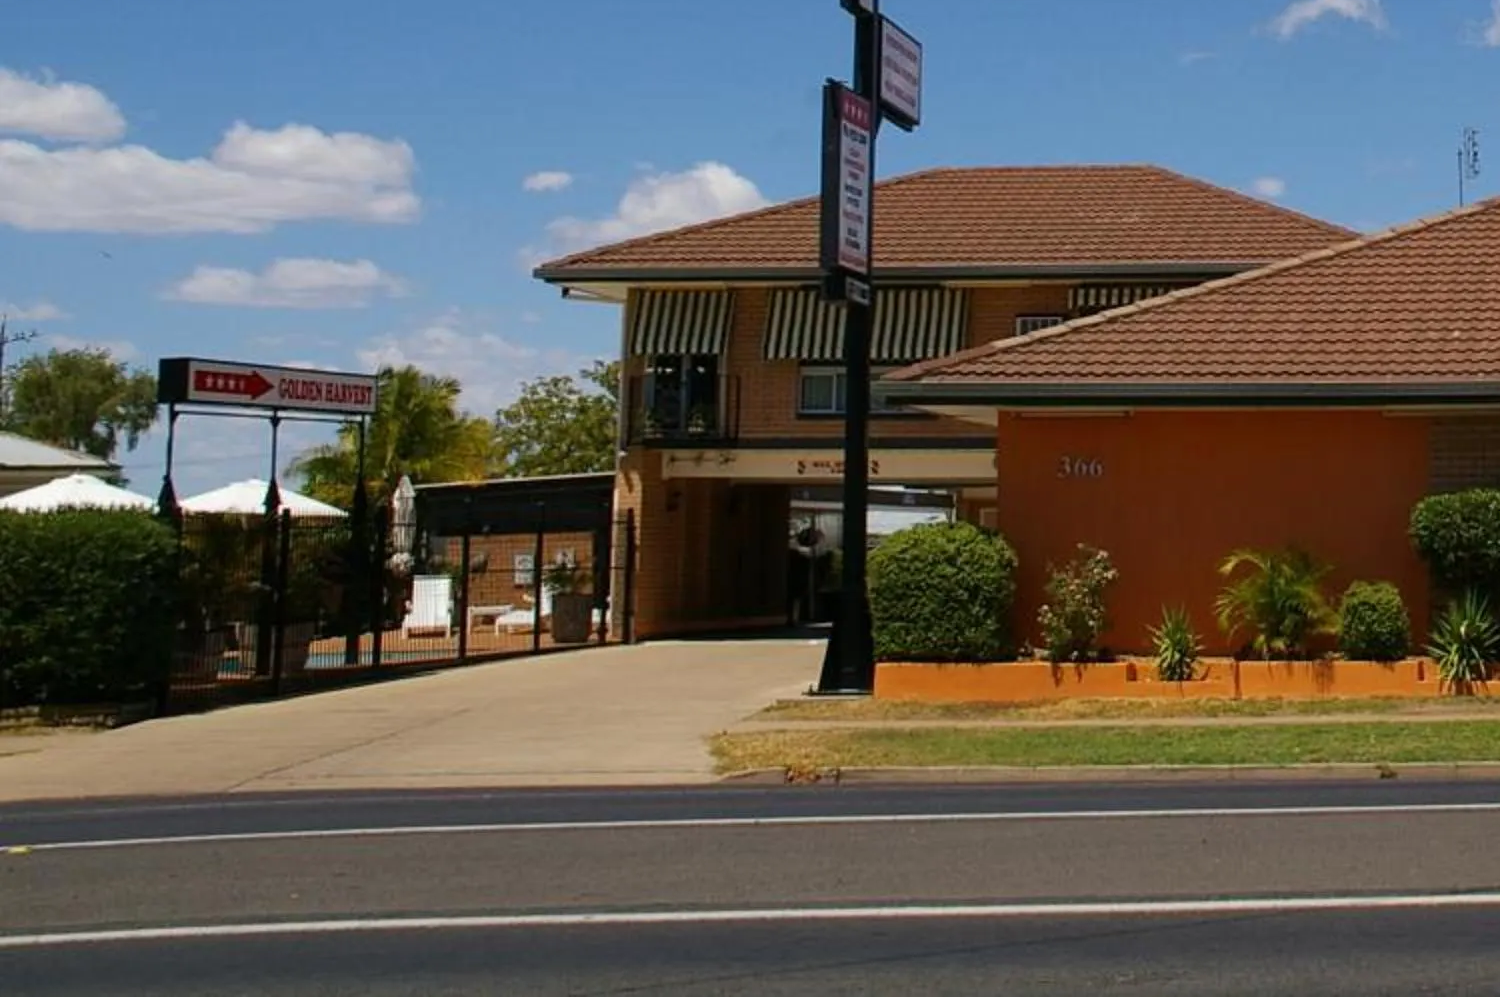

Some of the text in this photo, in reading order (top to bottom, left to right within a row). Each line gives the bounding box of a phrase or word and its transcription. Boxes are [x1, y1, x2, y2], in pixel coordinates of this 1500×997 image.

[278, 378, 372, 405] GOLDEN HARVEST
[1056, 456, 1102, 478] 366
